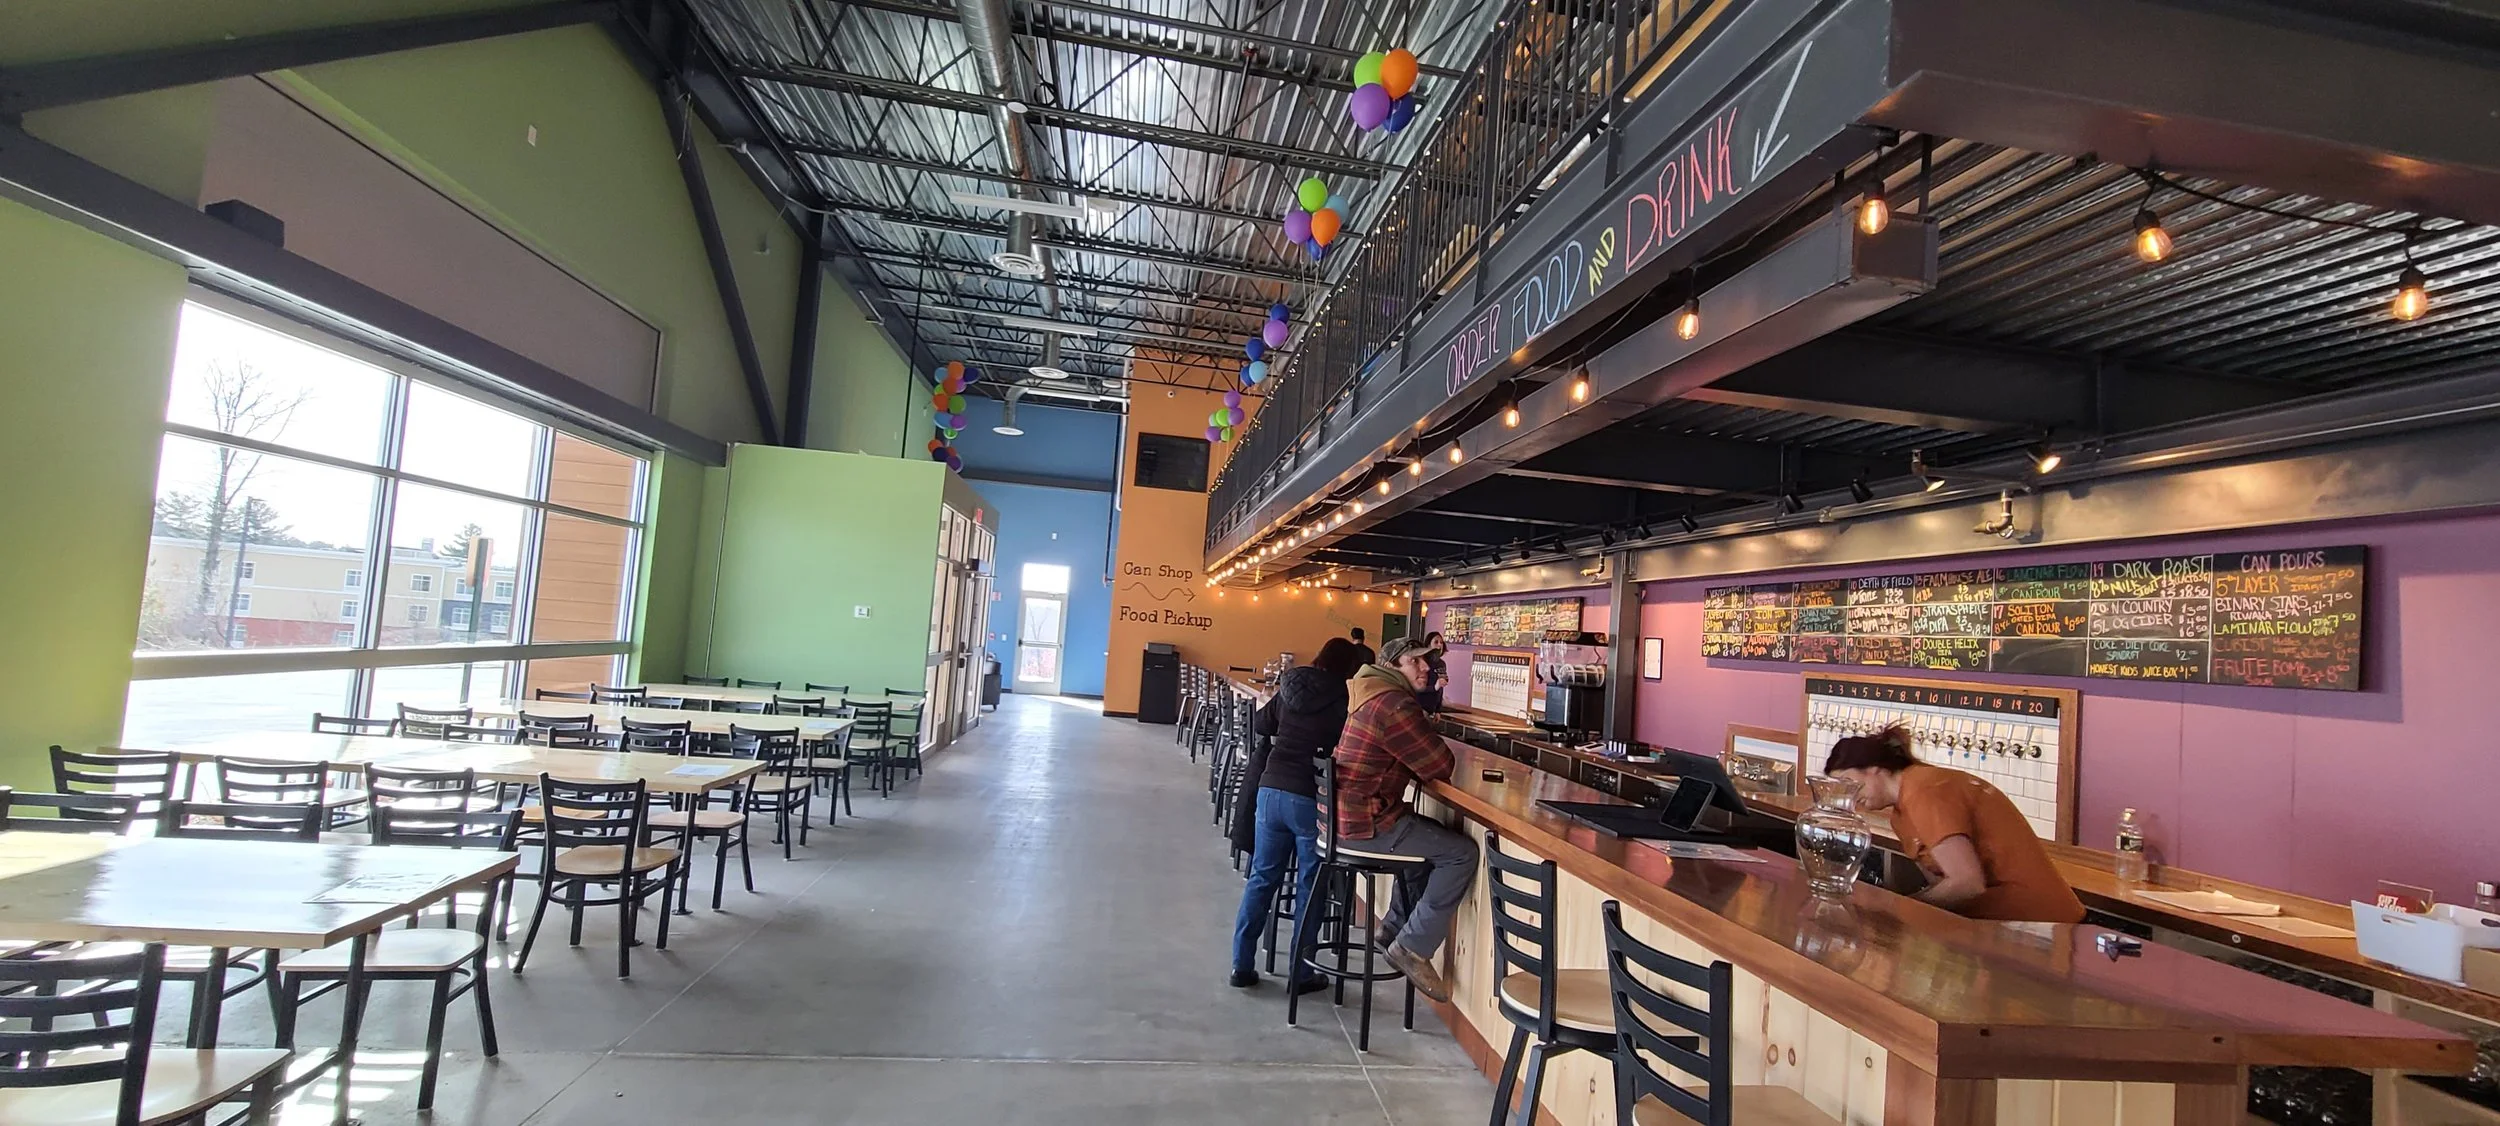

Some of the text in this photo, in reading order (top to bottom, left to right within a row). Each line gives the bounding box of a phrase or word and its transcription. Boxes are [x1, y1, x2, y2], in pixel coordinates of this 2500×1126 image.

[1446, 107, 1742, 398] ORDER FOOD AND DRINK
[2093, 555, 2213, 579] 19 DARK ROAST
[2241, 551, 2325, 573] CAN POURS
[1124, 562, 1192, 582] Can Shop
[1859, 578, 1879, 589] DEPTH
[1890, 577, 1912, 588] FIELD
[2111, 580, 2140, 595] MILK
[2235, 575, 2279, 593] LAYER
[2012, 589, 2032, 599] CAN
[2037, 587, 2060, 598] POUR
[1994, 603, 2054, 619] 17 SOLITON
[2111, 601, 2119, 614] N
[2122, 600, 2173, 614] COUNTRY
[2215, 596, 2266, 612] BINARY
[2270, 595, 2308, 611] STARS
[1120, 606, 1212, 630] Food Pickup
[2113, 617, 2129, 629] OG
[2131, 614, 2173, 627] CIDER
[2230, 611, 2273, 621] RIWAKA
[1929, 616, 1949, 633] DIPA
[2016, 623, 2034, 635] CAN
[2037, 622, 2060, 634] POUR
[2214, 621, 2274, 635] LAMINAR
[2277, 621, 2312, 634] FLOW
[1923, 638, 1952, 650] DOUBLE
[1955, 638, 1979, 649] HELIX
[1941, 657, 1960, 668] POUR
[2090, 664, 2118, 674] HONEST
[2120, 666, 2138, 676] KIDS
[2143, 666, 2161, 677] JUICE
[2163, 666, 2178, 678] BOX
[1828, 684, 1833, 693] 2
[1839, 685, 1844, 694] 3
[1851, 687, 1857, 696] 4
[1863, 687, 1869, 697] 5
[1875, 687, 1881, 698] 6
[1887, 689, 1894, 698] 7
[1900, 690, 1906, 701] 8
[1915, 690, 1920, 701] 9
[1929, 692, 1938, 704] 10
[1944, 693, 1951, 704] 11
[1960, 695, 1970, 705] 12
[2011, 699, 2022, 710] 19
[2028, 702, 2042, 713] 20
[2378, 894, 2398, 906] GIFT
